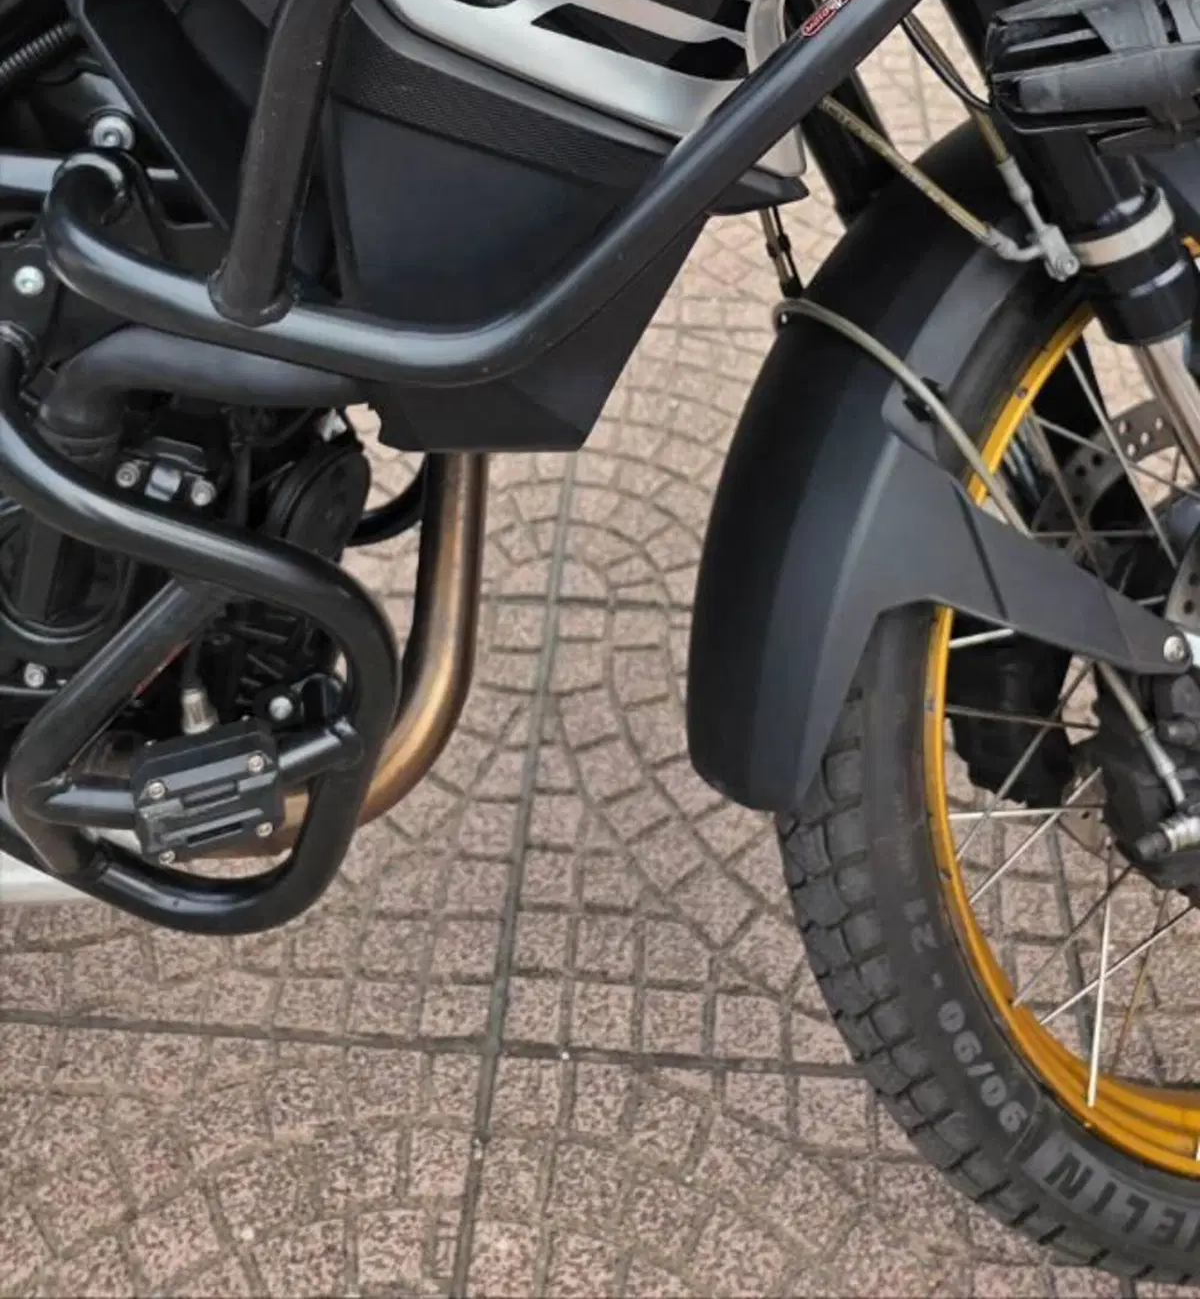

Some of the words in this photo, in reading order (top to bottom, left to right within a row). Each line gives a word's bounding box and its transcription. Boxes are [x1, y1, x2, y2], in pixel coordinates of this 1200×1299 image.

[904, 899, 938, 953] 21
[938, 1000, 1028, 1133] 90/90
[1043, 1151, 1200, 1253] ELIN
